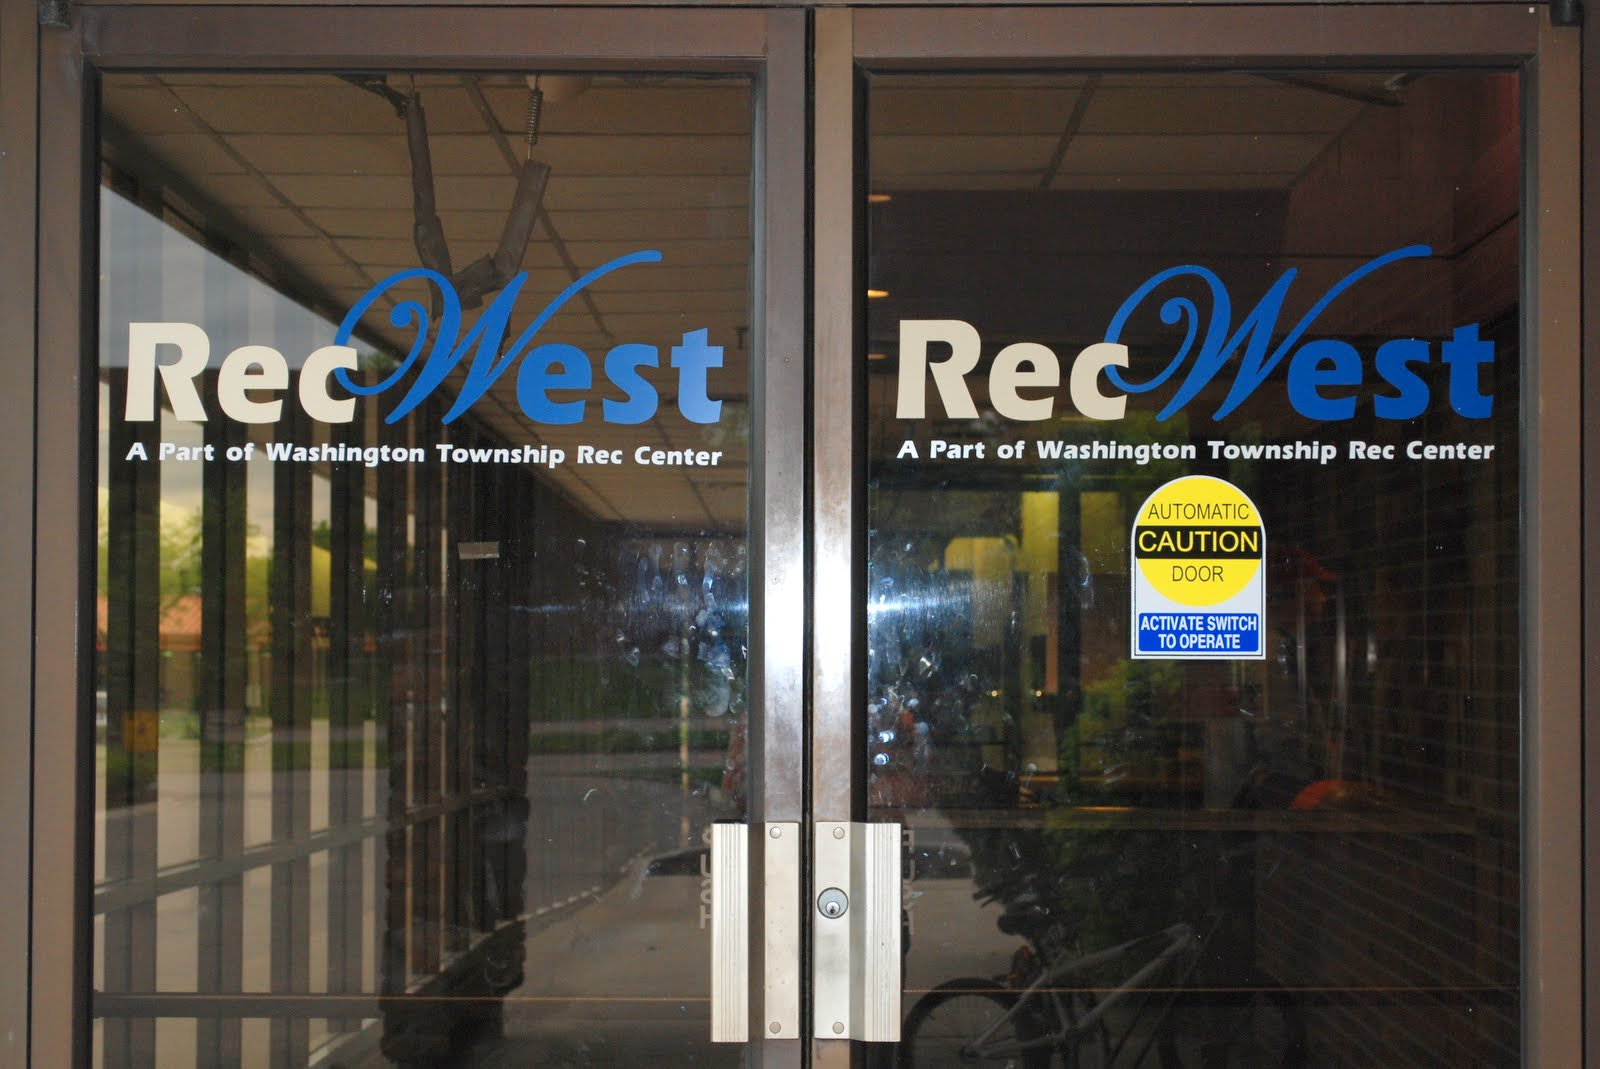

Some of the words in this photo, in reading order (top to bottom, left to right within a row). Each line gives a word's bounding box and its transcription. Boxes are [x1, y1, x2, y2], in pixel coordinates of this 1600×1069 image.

[125, 442, 148, 461] A
[158, 441, 215, 461] Part
[225, 441, 255, 461] of
[265, 442, 425, 467] Washington
[435, 443, 565, 468] Township
[576, 445, 623, 465] Rec
[634, 446, 723, 466] Center
[896, 440, 919, 459] A
[929, 440, 986, 459] Part
[996, 440, 1026, 459] of
[1036, 439, 1196, 465] Washington
[1207, 440, 1337, 465] Township
[1348, 440, 1395, 459] Rec
[1406, 440, 1495, 460] Center
[1147, 503, 1250, 520] AUTOMATIC
[1138, 530, 1258, 553] CAUTION
[1172, 565, 1224, 582] DOOR
[1140, 615, 1204, 631] ACTIVATE
[1207, 615, 1257, 631] SWITCH
[1158, 633, 1177, 649] TO
[1179, 633, 1241, 649] OPERATE
